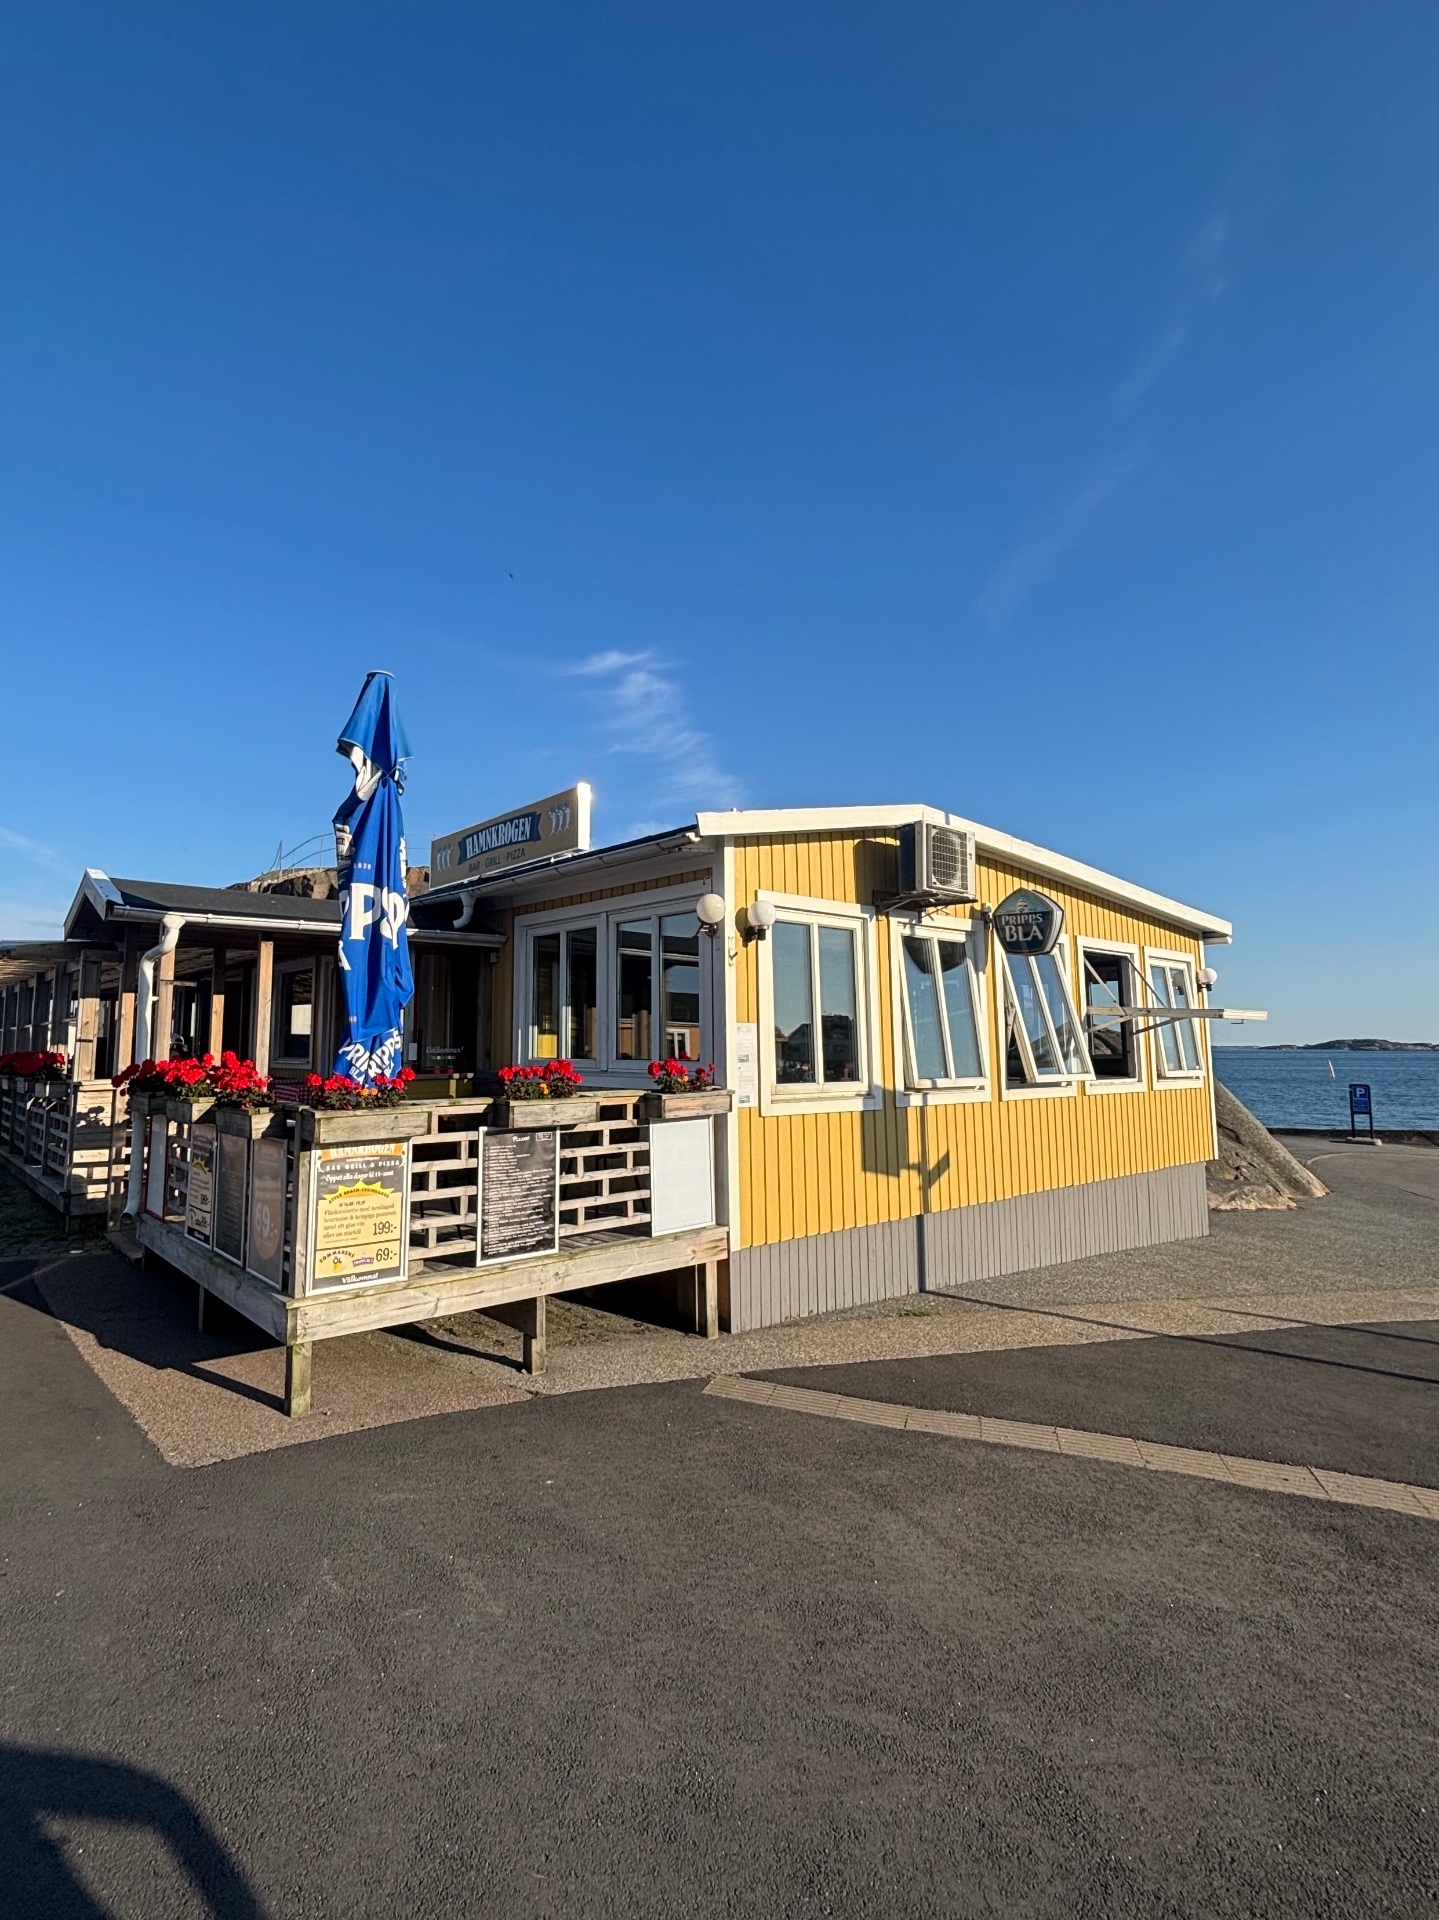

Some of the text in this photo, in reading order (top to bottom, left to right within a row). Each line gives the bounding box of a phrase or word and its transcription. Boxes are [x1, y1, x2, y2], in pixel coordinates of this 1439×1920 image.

[466, 816, 532, 860] HAMNKROGEN
[468, 848, 526, 873] BAR GRILL PIZZA
[1001, 913, 1043, 926] PRIPPS
[1005, 920, 1044, 942] BLÅ
[1356, 1087, 1365, 1098] P
[344, 1162, 367, 1170] GRILL
[372, 1220, 398, 1236] 199:-
[332, 1256, 343, 1265] ÖL
[375, 1247, 398, 1262] 69:-
